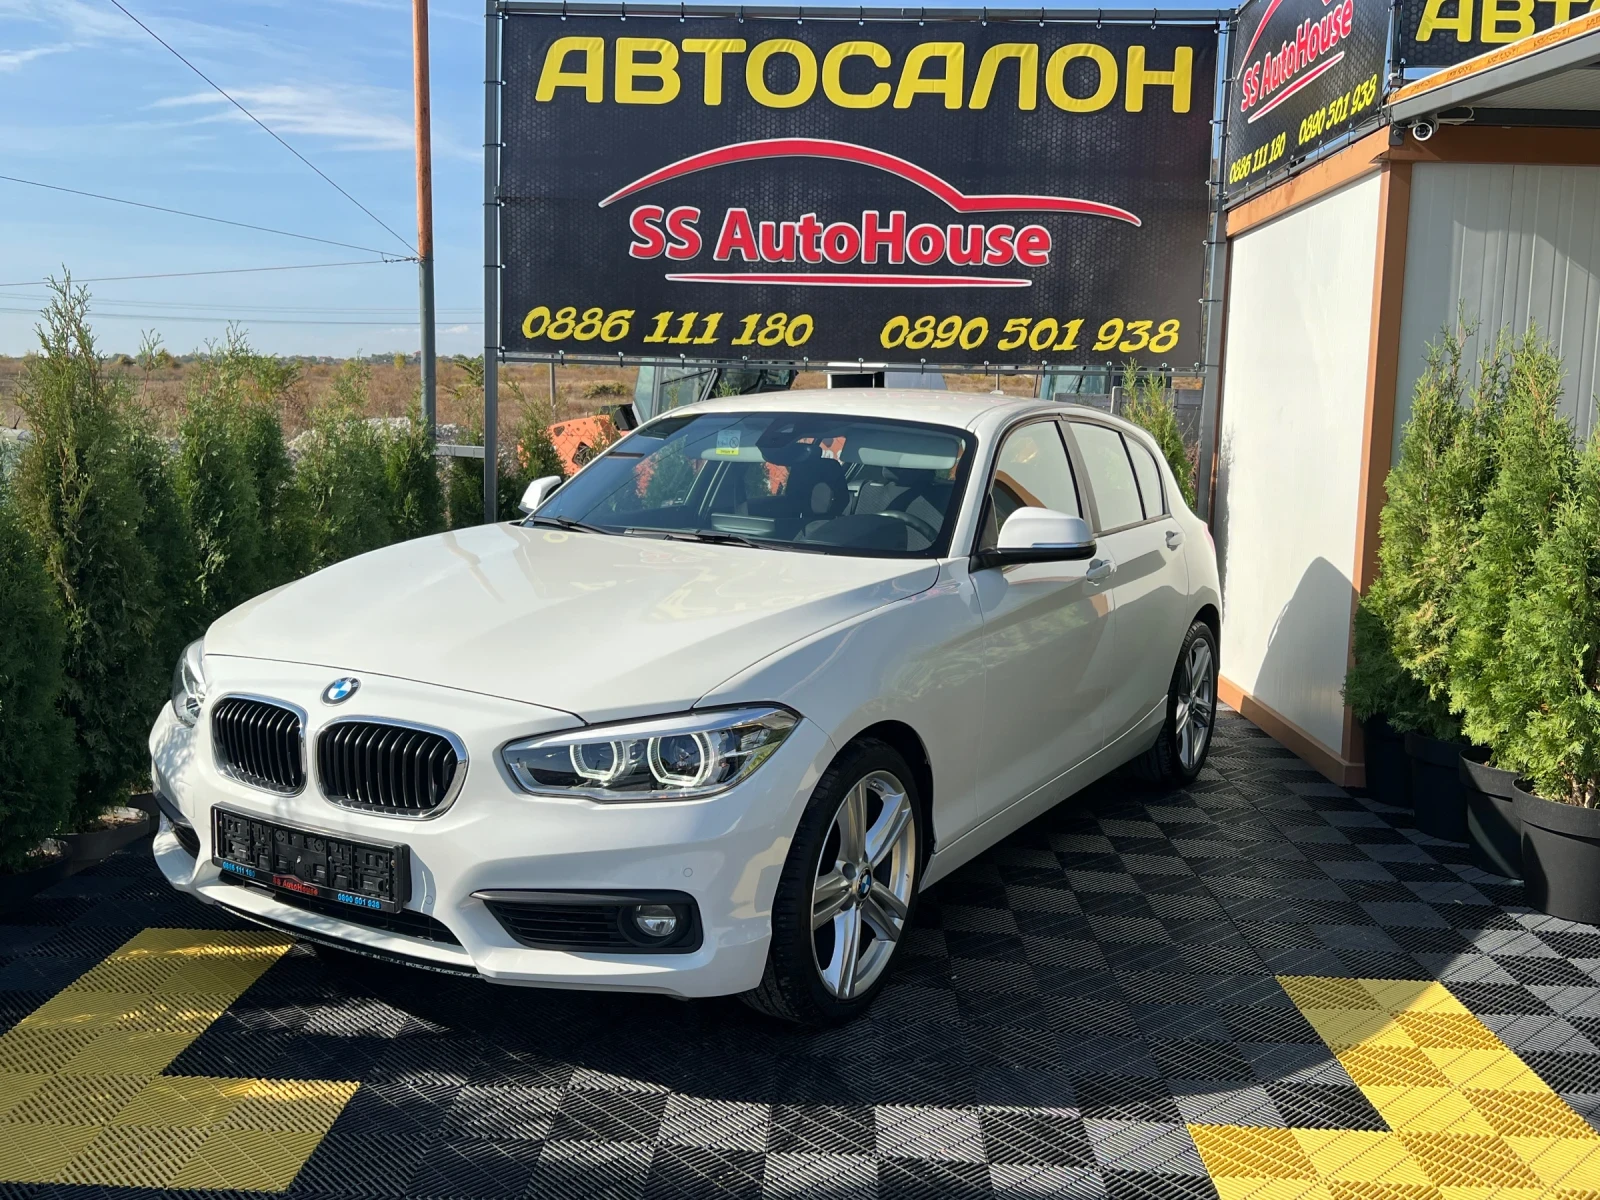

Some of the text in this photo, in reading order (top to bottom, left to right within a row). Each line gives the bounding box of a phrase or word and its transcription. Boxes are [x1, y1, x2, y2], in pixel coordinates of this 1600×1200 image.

[1415, 0, 1600, 43] АВТ
[536, 36, 1194, 114] АВТОСАЛОН
[1241, 0, 1353, 112] SS AutoHouse
[1298, 73, 1378, 145] 0890 501 938
[1229, 131, 1286, 185] 0886 111 180
[629, 205, 1051, 266] SS AutoHouse
[521, 305, 815, 347] 0886 111 180
[880, 315, 1181, 353] 0890 501 938
